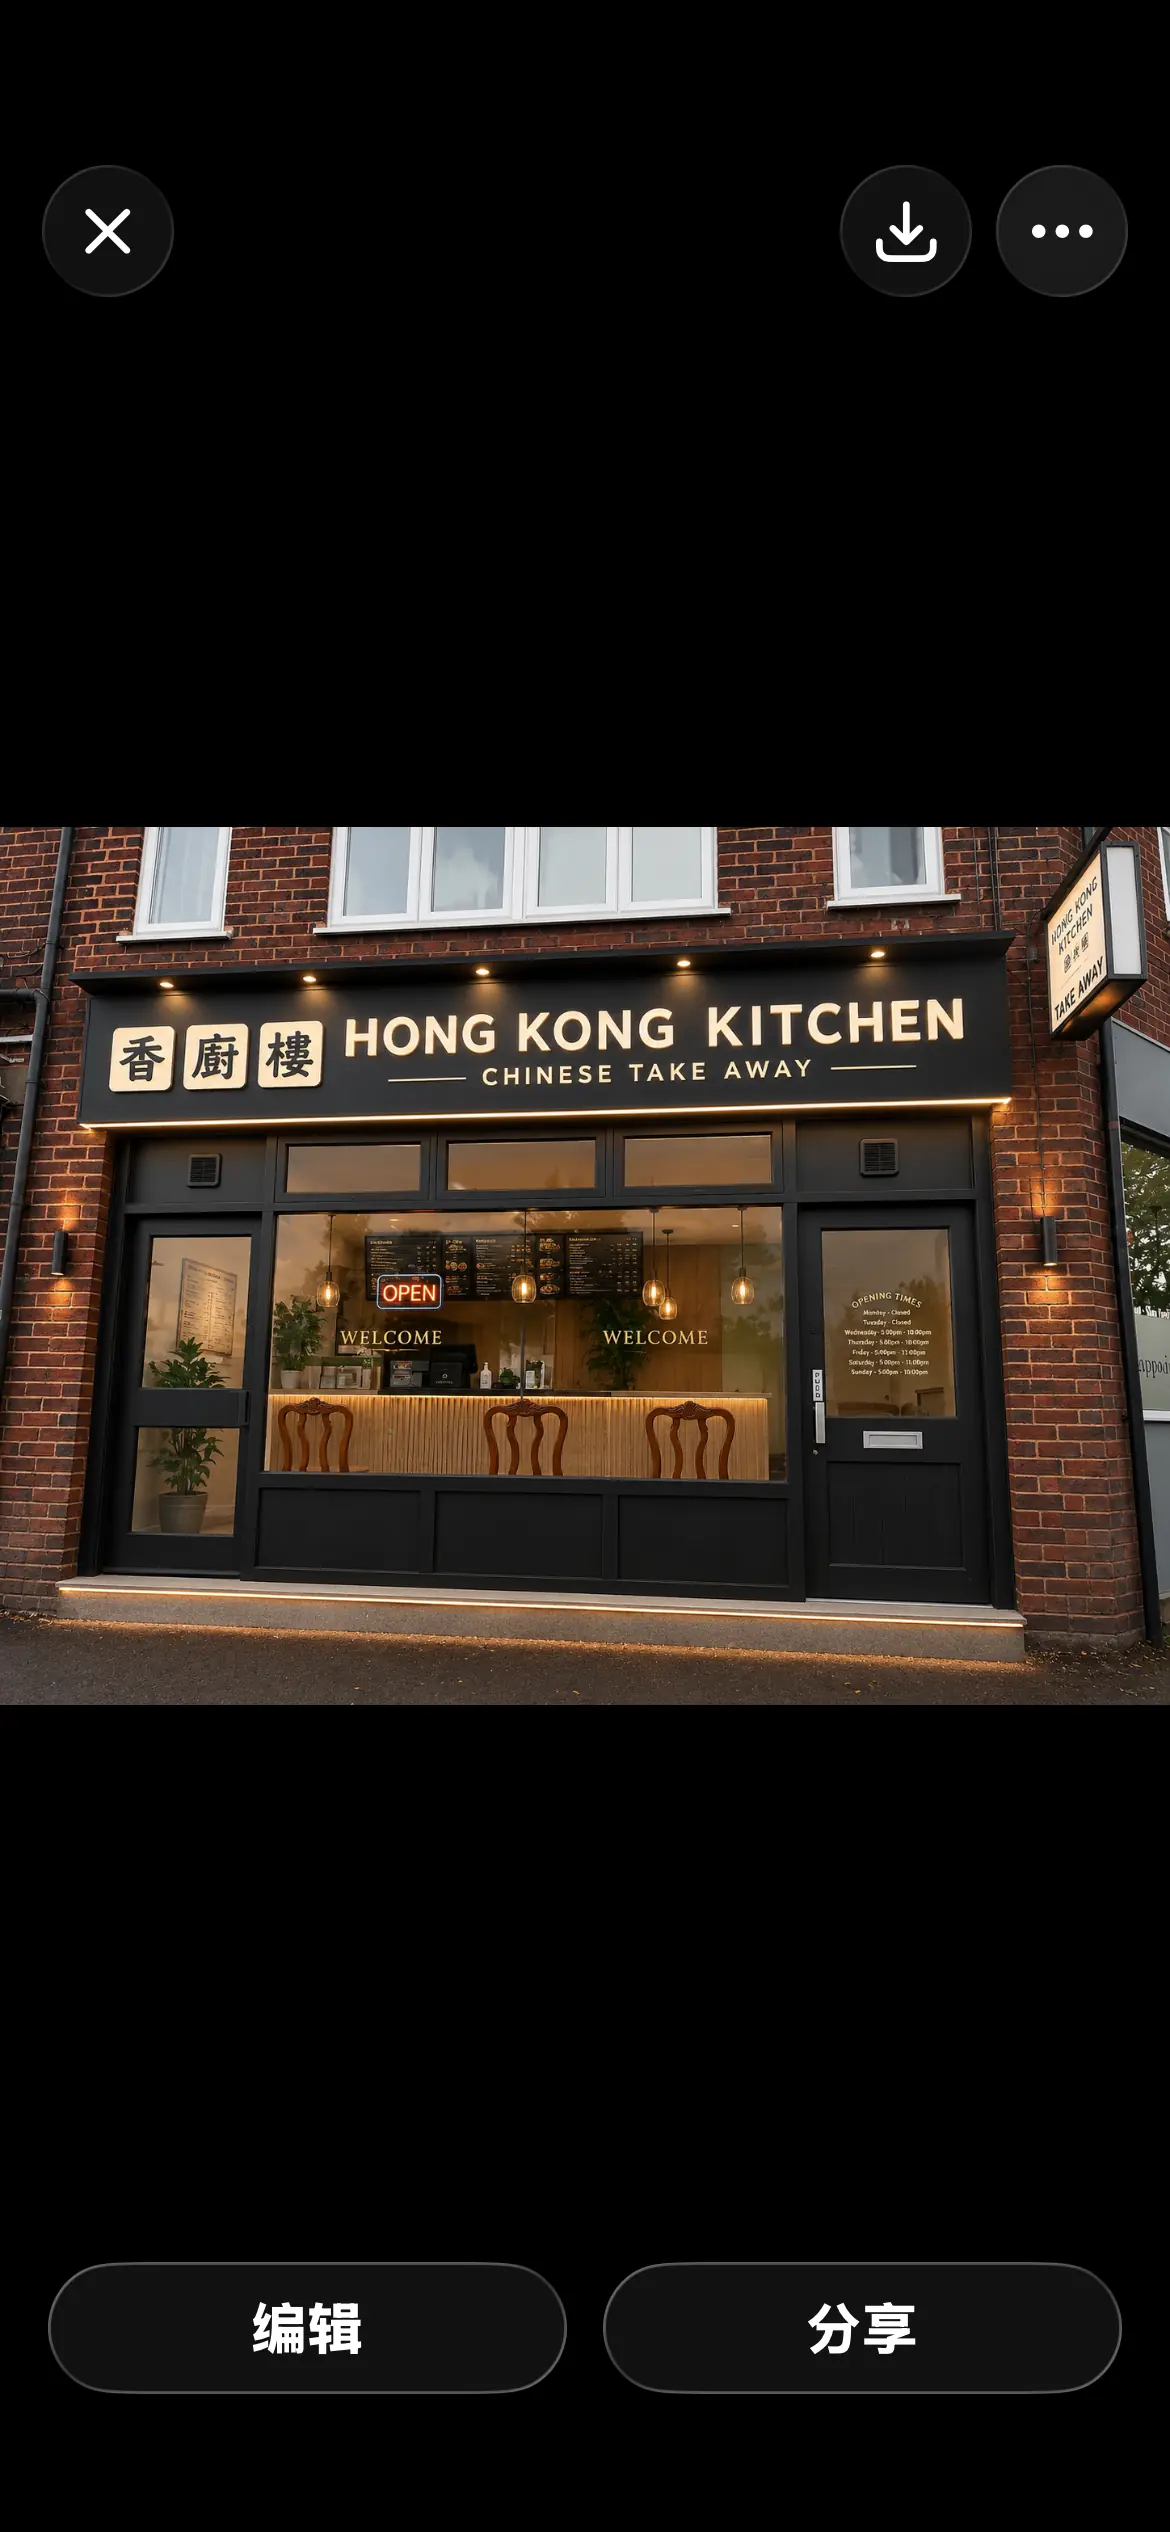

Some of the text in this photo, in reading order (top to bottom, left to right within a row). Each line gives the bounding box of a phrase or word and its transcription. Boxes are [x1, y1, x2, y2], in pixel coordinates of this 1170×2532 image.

[1075, 876, 1098, 914] KONG
[1058, 903, 1093, 956] KITCHEN
[1054, 956, 1104, 1021] TAKE AWAY
[345, 998, 965, 1057] HONG KONG KITCHEN
[119, 1030, 314, 1082] 香廚樓
[482, 1058, 812, 1086] CHINESE TAKE AWAY
[382, 1284, 436, 1302] OPEN
[851, 1292, 922, 1308] OPENING TIMES
[340, 1330, 442, 1346] WELCOME
[603, 1330, 708, 1346] WELCOME
